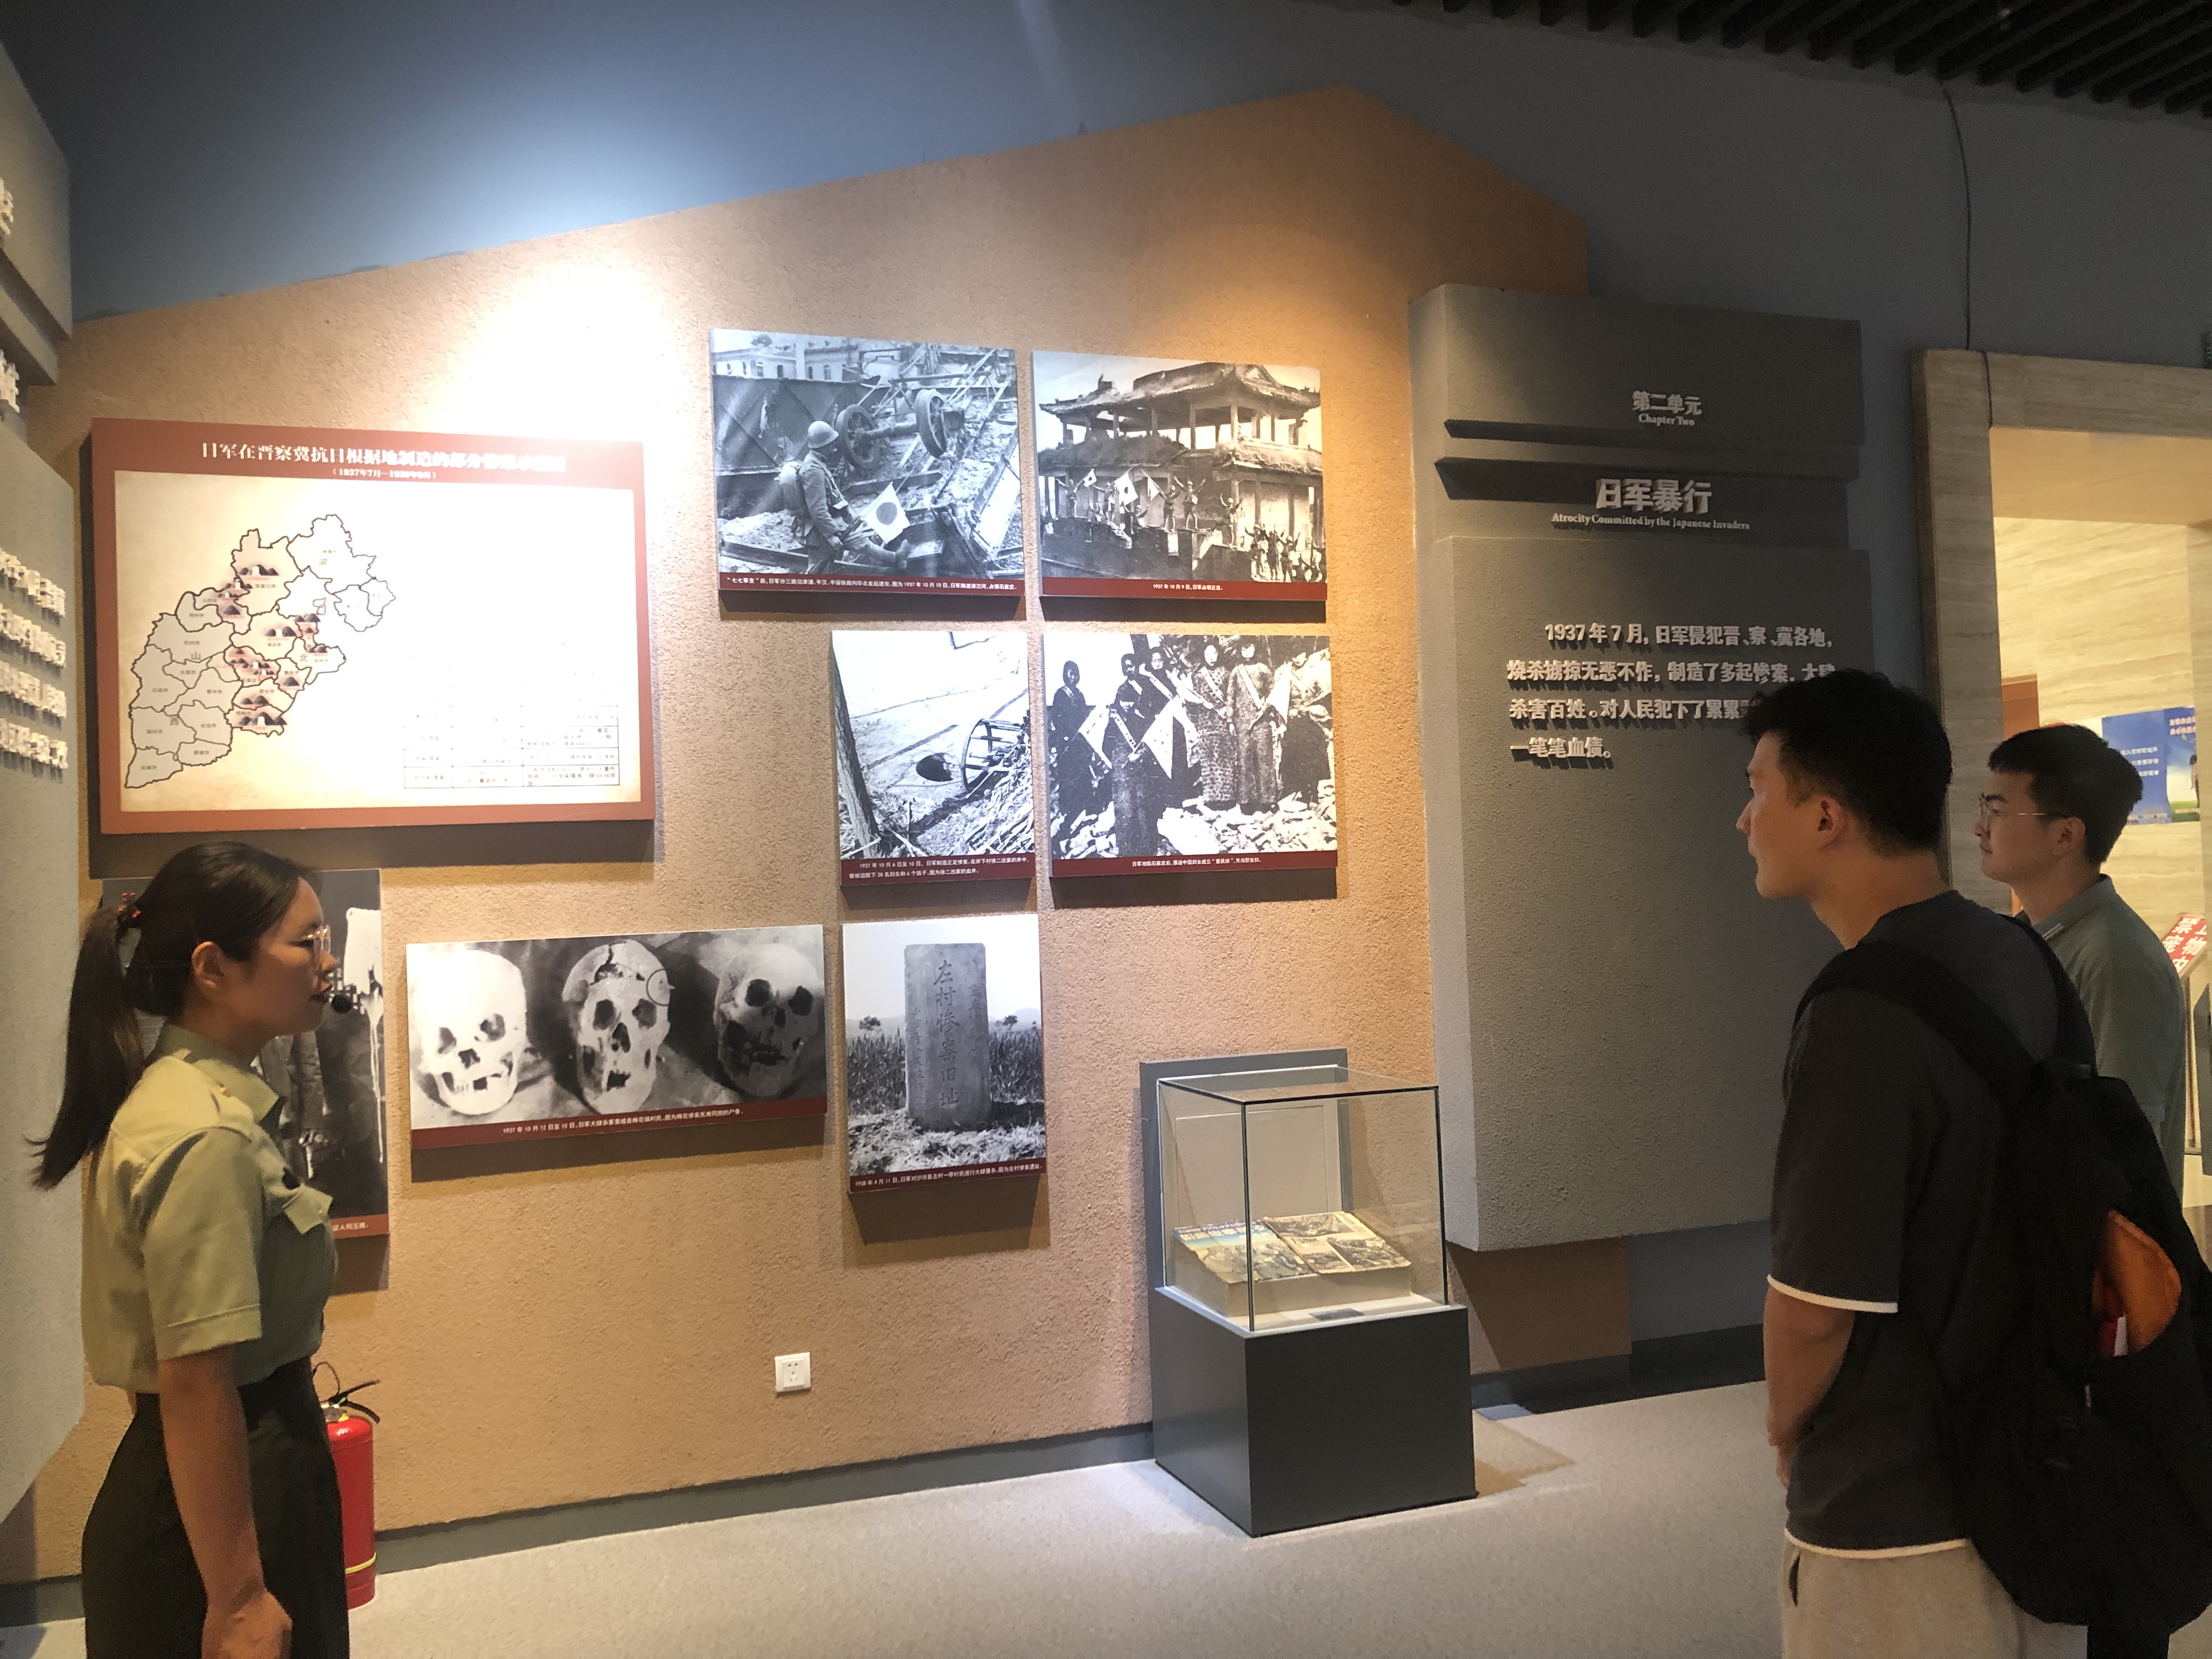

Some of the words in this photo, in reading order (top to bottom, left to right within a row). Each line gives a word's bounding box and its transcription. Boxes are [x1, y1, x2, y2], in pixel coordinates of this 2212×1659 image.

[1632, 390, 1702, 415] 第二单元
[1639, 413, 1675, 426] Chapter
[1676, 415, 1695, 426] Two
[1596, 478, 1712, 514] 日军暴行
[1552, 512, 1590, 526] Atrocity
[1592, 514, 1643, 526] Committed
[1645, 516, 1655, 527] by
[1656, 516, 1671, 527] the
[1672, 517, 1711, 529] Japanese
[1713, 520, 1750, 531] Invaders
[933, 960, 960, 1107] 左村惨案旧址
